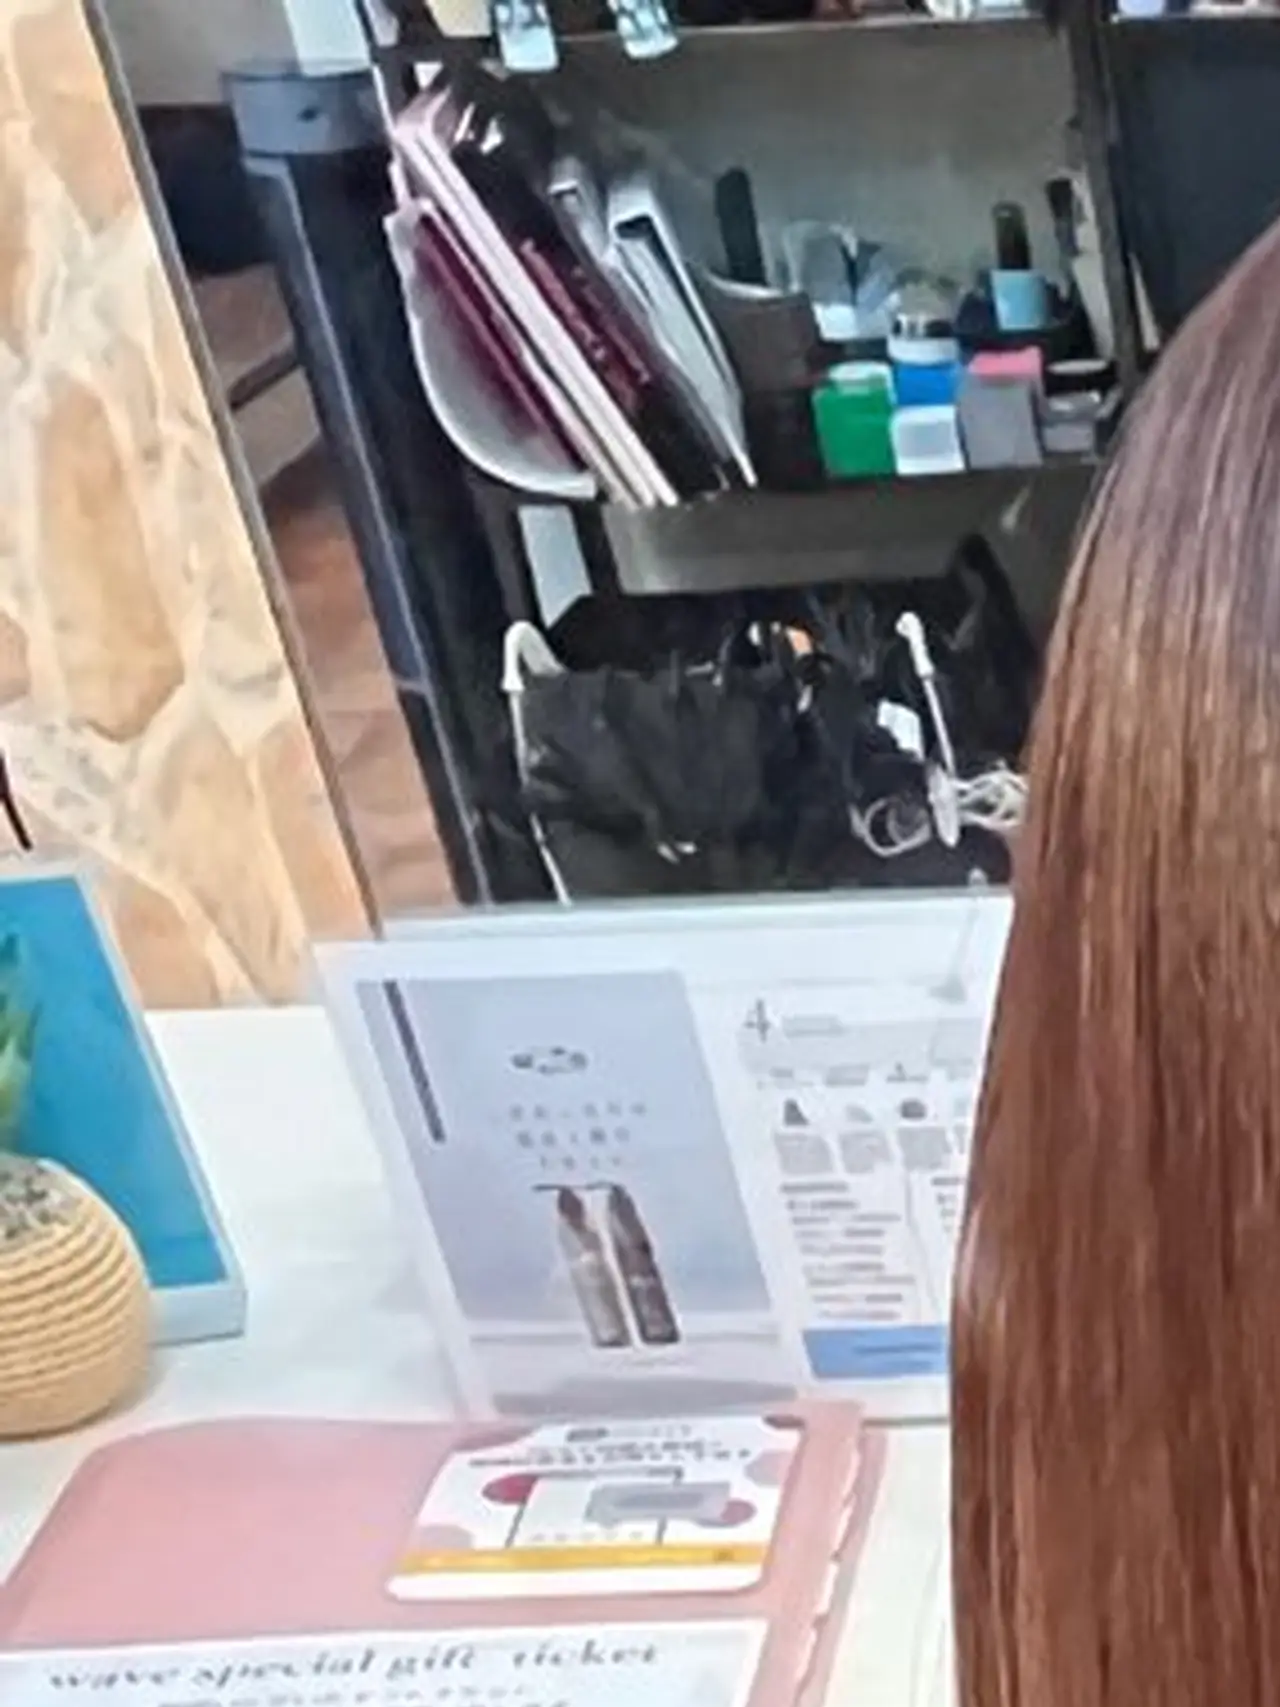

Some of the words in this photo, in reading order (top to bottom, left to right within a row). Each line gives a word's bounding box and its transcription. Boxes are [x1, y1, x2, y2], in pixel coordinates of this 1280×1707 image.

[50, 1665, 181, 1690] wave
[191, 1648, 375, 1690] special
[385, 1645, 475, 1682] gift
[512, 1638, 657, 1668] ticket
